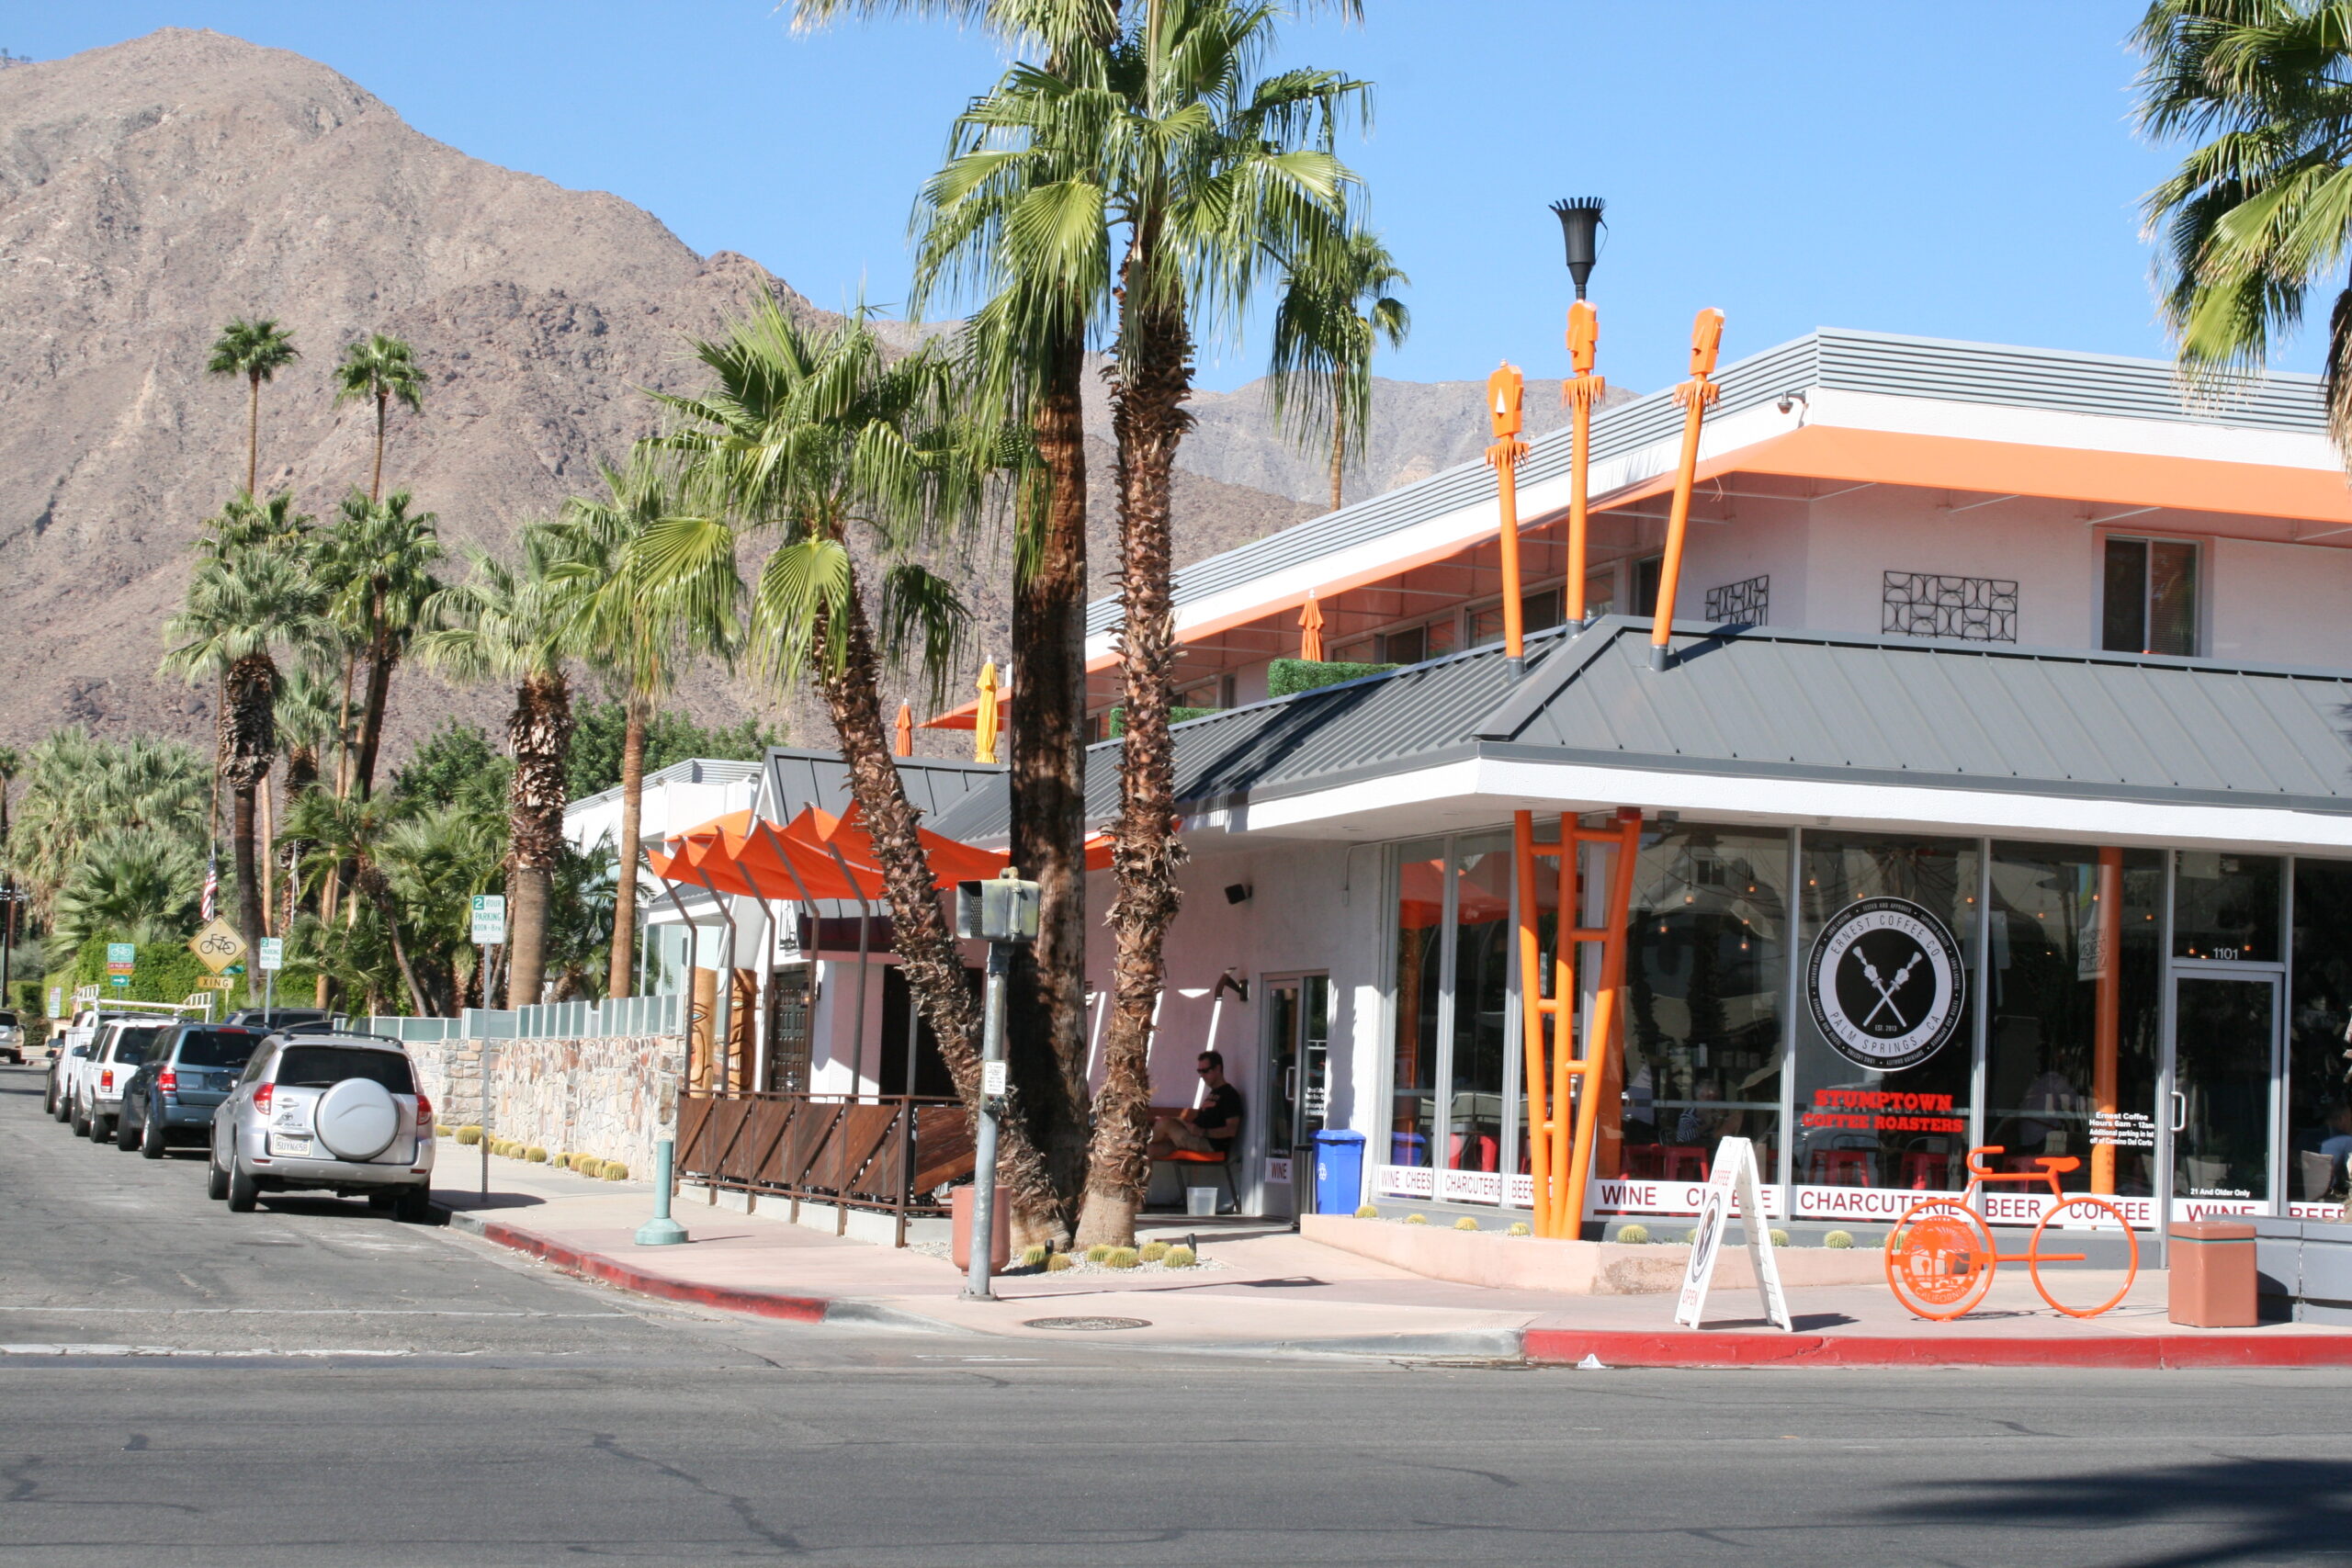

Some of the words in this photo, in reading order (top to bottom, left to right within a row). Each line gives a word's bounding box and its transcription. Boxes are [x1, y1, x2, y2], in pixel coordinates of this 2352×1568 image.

[474, 897, 482, 908] 2
[486, 899, 502, 908] HOUR
[475, 912, 502, 921] PARKING
[1831, 917, 1871, 954] ERNEST
[1880, 914, 1925, 939] COFFEE
[2212, 947, 2238, 960] 1101
[203, 977, 229, 987] XING
[1829, 1011, 1858, 1043] PALM
[1927, 1015, 1941, 1031] CA
[1814, 1089, 1953, 1112] STUMPTOWN
[1802, 1112, 1870, 1130] COFFEE
[1873, 1116, 1964, 1134] ROASTERS
[2088, 1119, 2113, 1127] Hours
[2114, 1120, 2132, 1128] 6am
[2095, 1111, 2121, 1120] Ernest
[2122, 1112, 2149, 1121] Coffee
[2088, 1128, 2118, 1136] Additional
[2118, 1130, 2139, 1139] parking
[1271, 1162, 1287, 1179] WINE
[1381, 1169, 1400, 1188] WINE
[1406, 1171, 1433, 1190] CHEES
[1445, 1173, 1501, 1197] CHARCUTERIE
[2233, 1189, 2251, 1198] Only
[1601, 1185, 1657, 1206] WINE
[1800, 1190, 1961, 1216] CHARCUTERIE
[1984, 1198, 2041, 1218] BEER
[2069, 1201, 2151, 1221] COFFEE
[2289, 1207, 2345, 1219] BEE
[1682, 1288, 1698, 1306] OPEN
[1915, 1285, 1968, 1303] CALIFORNIA
